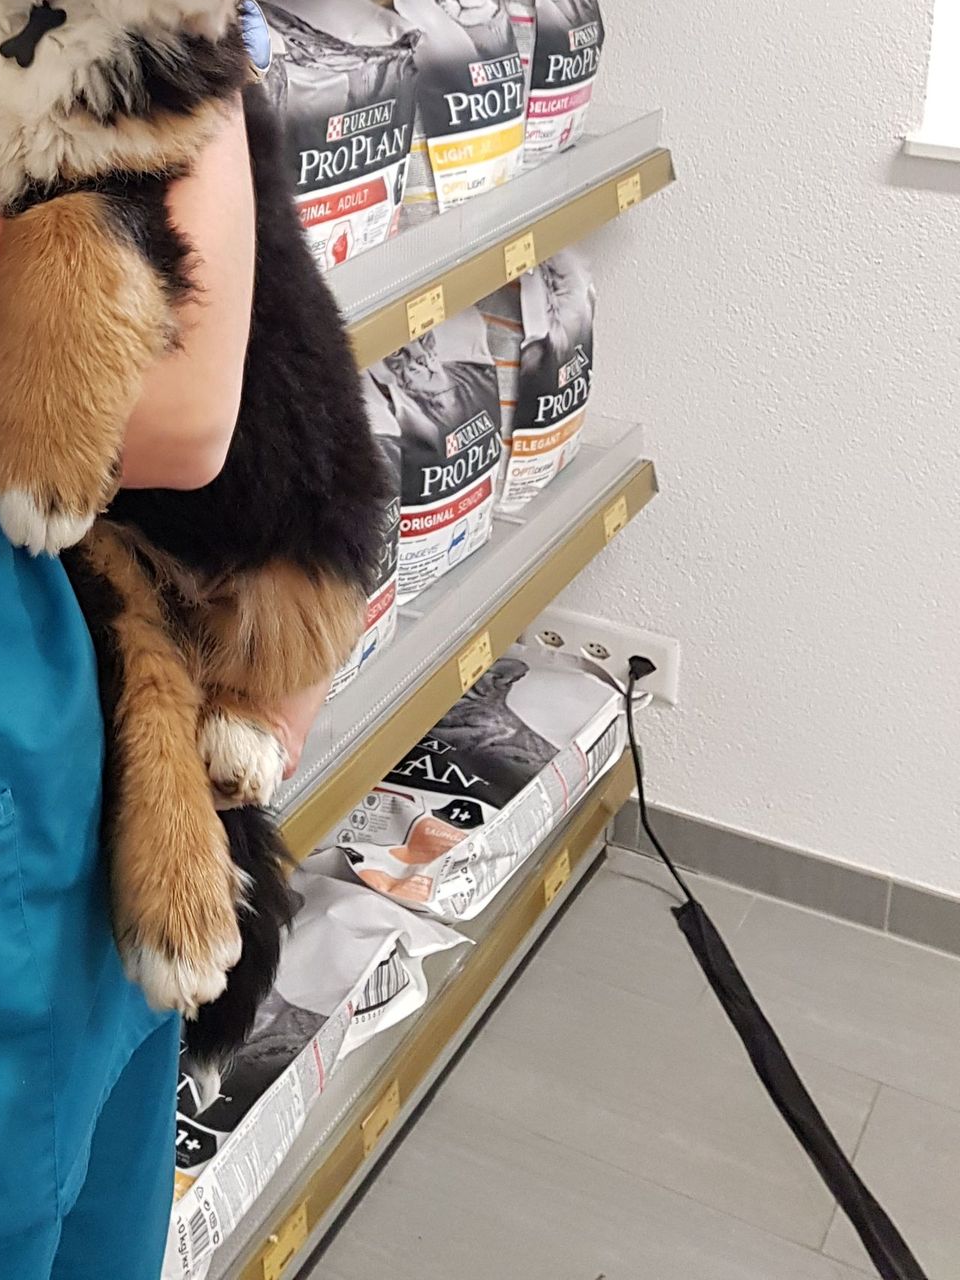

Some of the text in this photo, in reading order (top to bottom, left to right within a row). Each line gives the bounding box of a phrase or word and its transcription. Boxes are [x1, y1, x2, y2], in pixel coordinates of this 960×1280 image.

[343, 105, 390, 135] PURINA
[434, 145, 474, 165] LIGHT
[299, 188, 370, 221] GINAL ADULT
[456, 413, 493, 449] PURINA
[513, 431, 561, 452] ELEGANT
[400, 507, 455, 532] ORIGINAL
[449, 807, 472, 823] 1+
[176, 1129, 201, 1151] 1+
